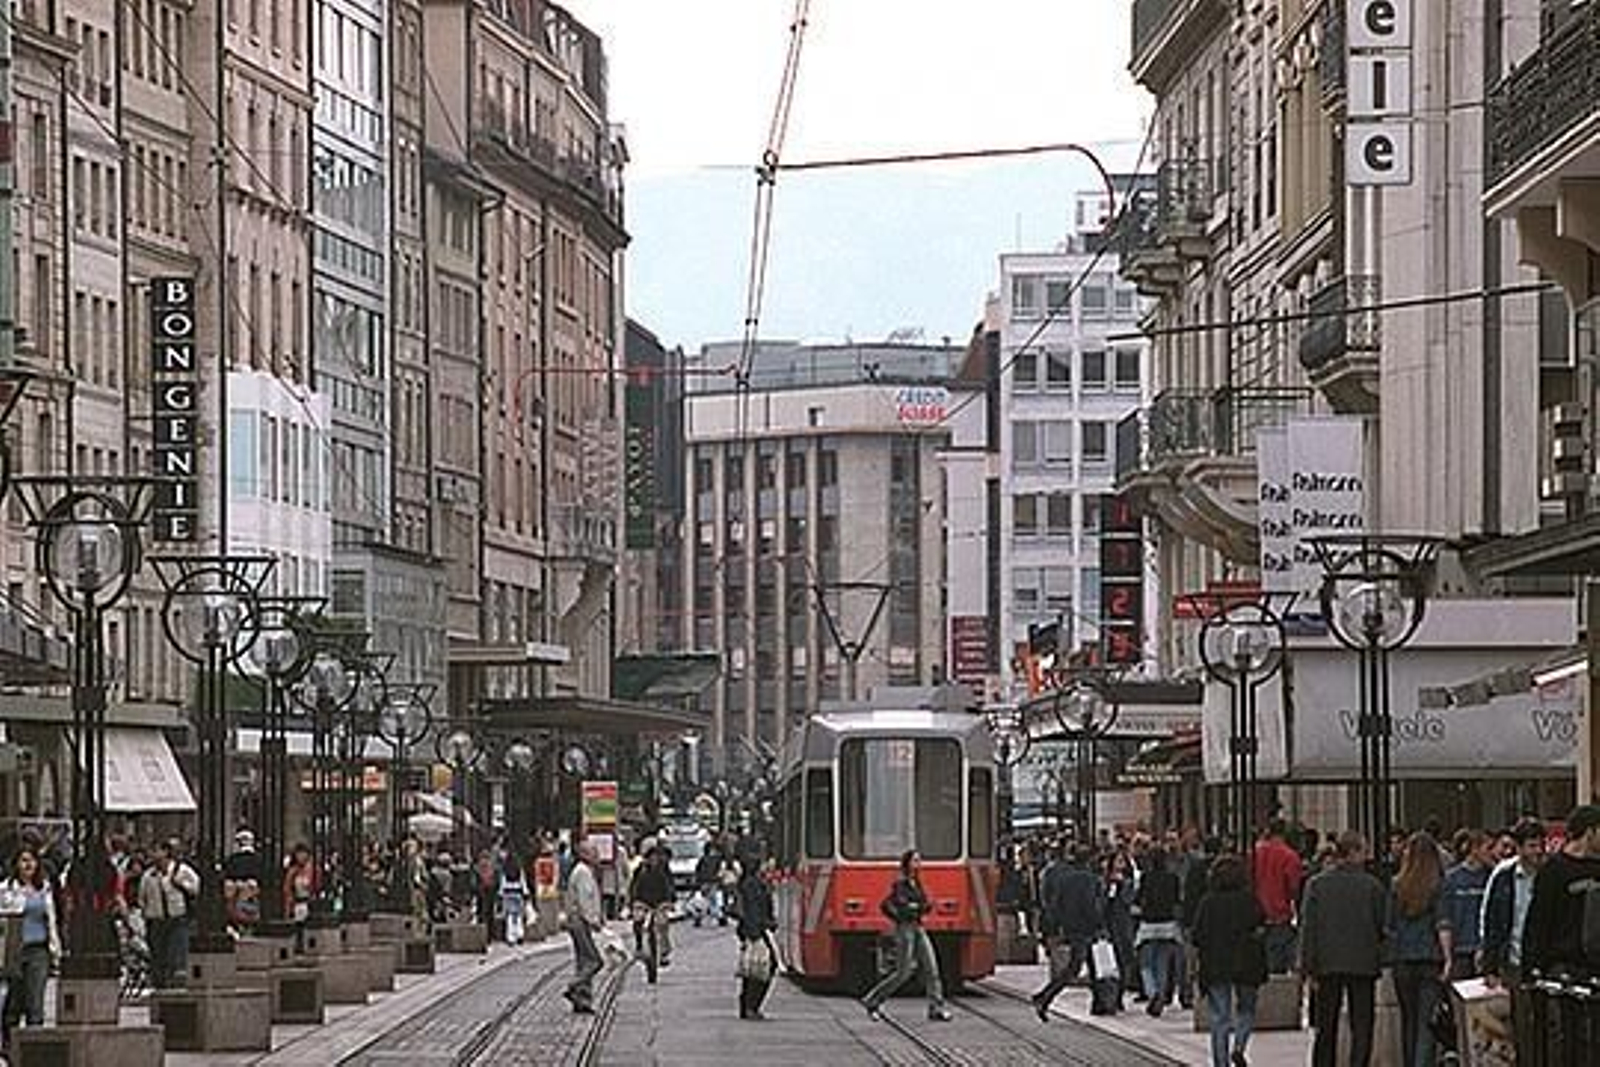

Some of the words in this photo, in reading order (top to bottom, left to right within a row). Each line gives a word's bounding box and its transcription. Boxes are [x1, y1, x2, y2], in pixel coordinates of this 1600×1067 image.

[162, 281, 192, 368] BON
[165, 386, 191, 539] GENIE
[1339, 709, 1446, 748] Vele
